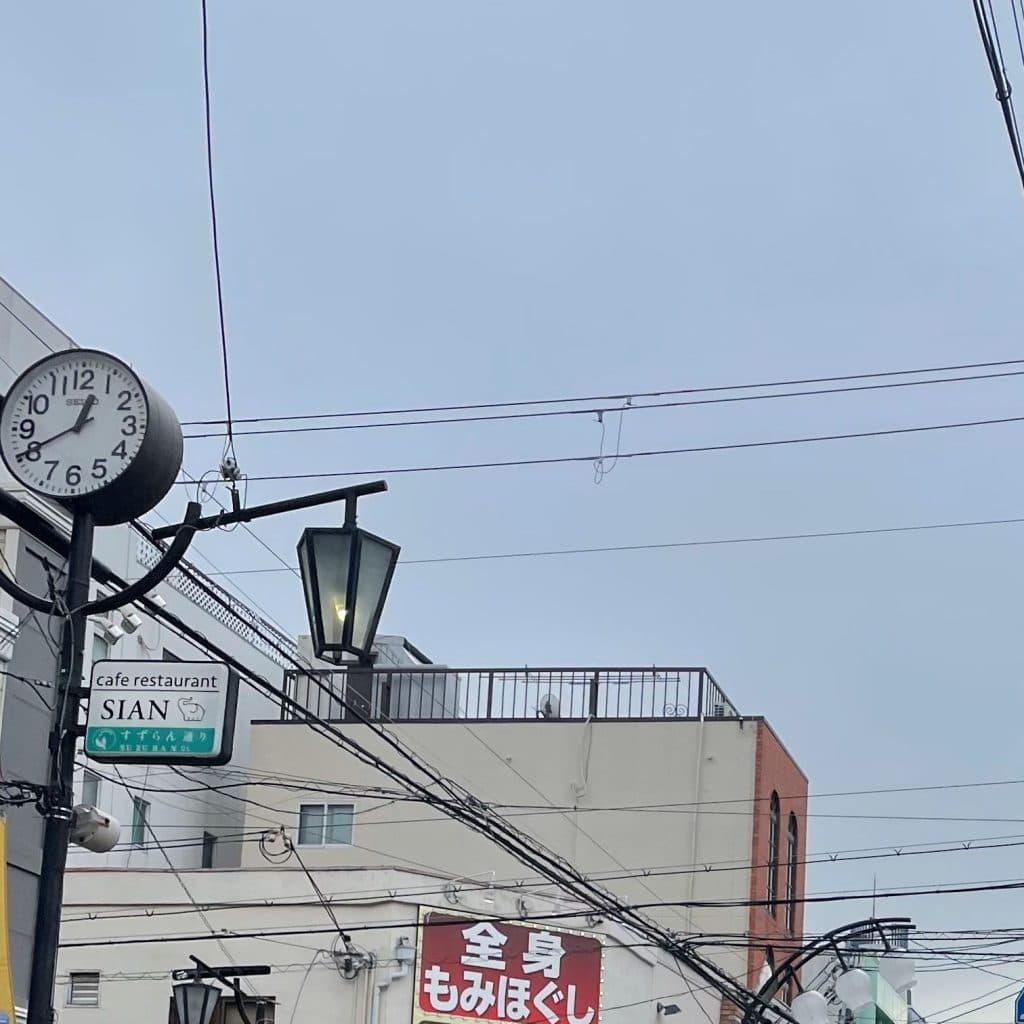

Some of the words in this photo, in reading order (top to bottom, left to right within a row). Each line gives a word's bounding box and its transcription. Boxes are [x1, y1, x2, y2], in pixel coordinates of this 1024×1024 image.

[50, 374, 68, 396] 11
[73, 369, 95, 391] 12
[105, 373, 111, 395] 1
[28, 394, 50, 415] 10
[65, 398, 100, 406] SEIO
[117, 390, 133, 411] 2
[19, 418, 35, 439] 9
[121, 415, 137, 436] 3
[26, 441, 41, 462] 8
[111, 440, 127, 460] 4
[44, 460, 60, 481] 7
[66, 465, 82, 486] 6
[91, 458, 107, 479] 5
[96, 672, 129, 687] cafe
[134, 675, 217, 688] restaurant
[100, 699, 169, 720] SIAN
